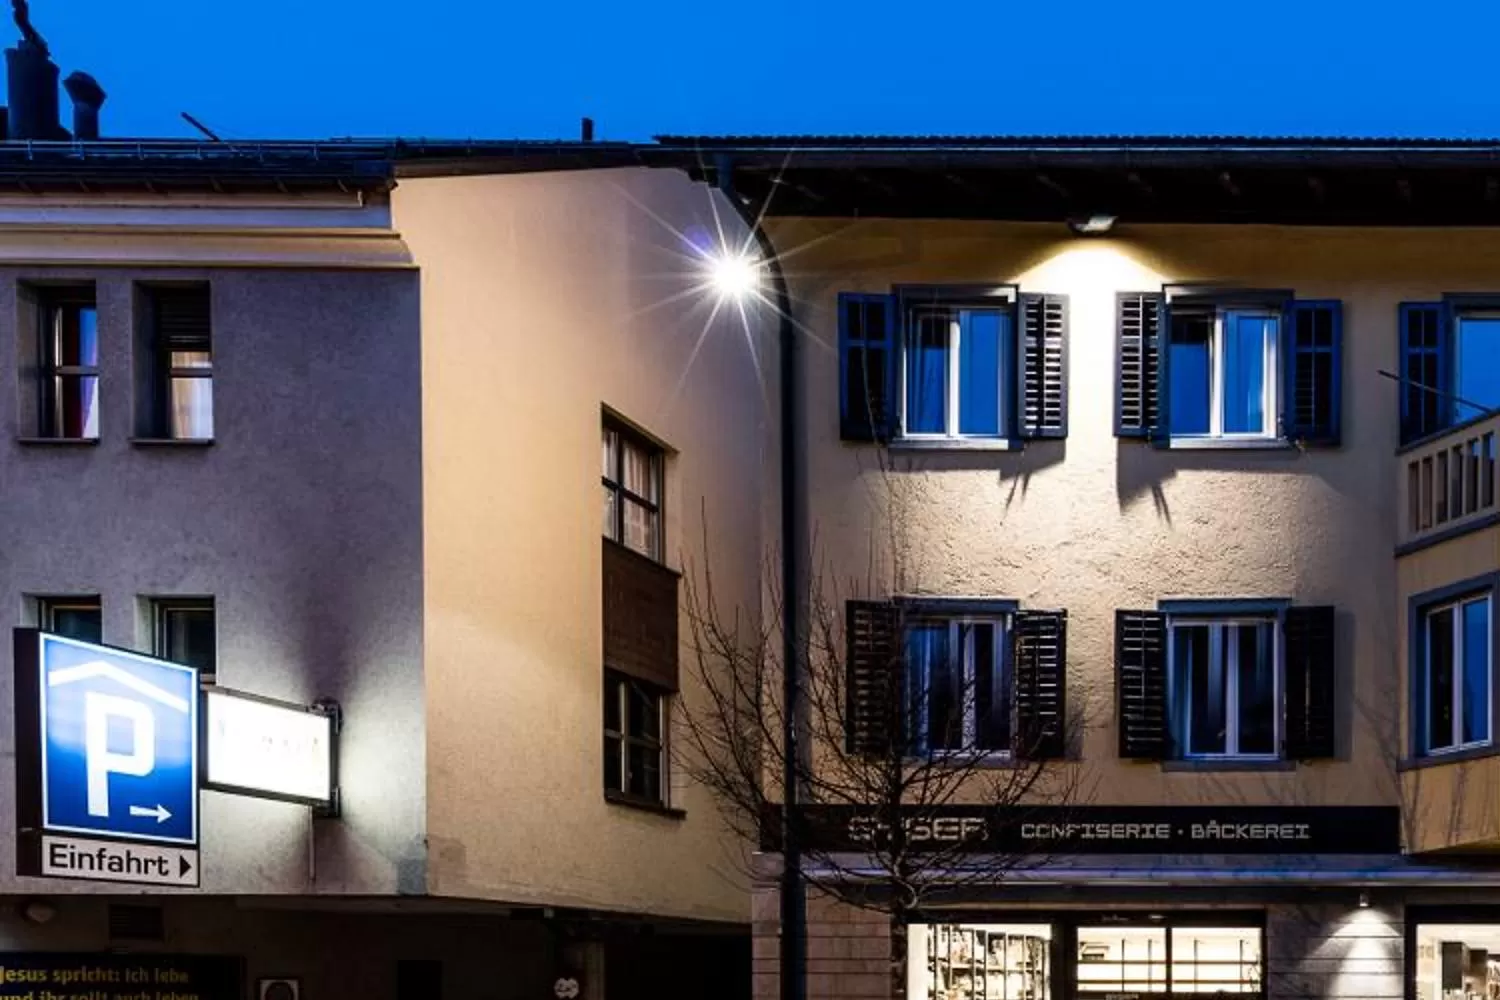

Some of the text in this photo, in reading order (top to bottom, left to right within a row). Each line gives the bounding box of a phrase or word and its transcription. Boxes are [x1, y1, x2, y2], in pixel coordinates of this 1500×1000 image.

[84, 691, 156, 817] P
[49, 843, 170, 878] Einfahrt
[0, 965, 48, 985] Jesus
